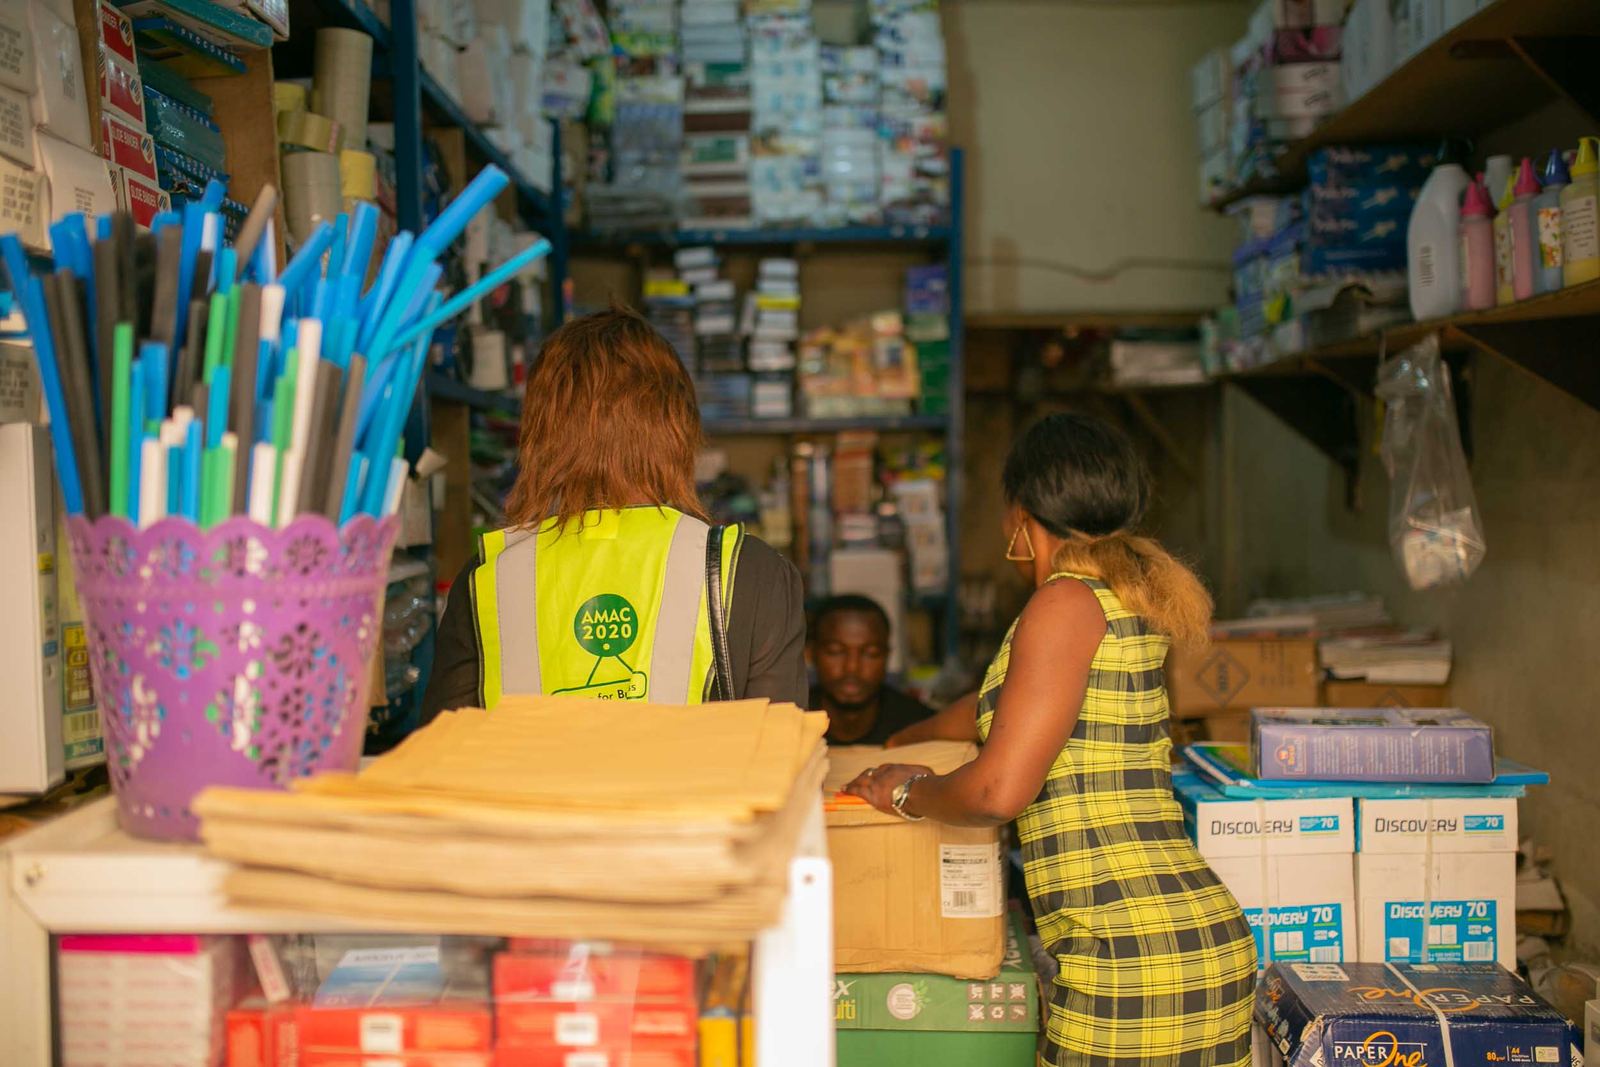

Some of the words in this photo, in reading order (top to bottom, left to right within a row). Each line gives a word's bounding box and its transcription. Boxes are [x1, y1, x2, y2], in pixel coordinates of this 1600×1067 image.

[582, 607, 631, 624] AMAC
[583, 623, 632, 640] 2020
[1321, 817, 1335, 829] 70
[1485, 816, 1499, 828] 70
[1311, 906, 1334, 923] 70
[1466, 901, 1488, 918] 70
[1334, 1045, 1389, 1060] PAPER
[1361, 1030, 1428, 1067] One
